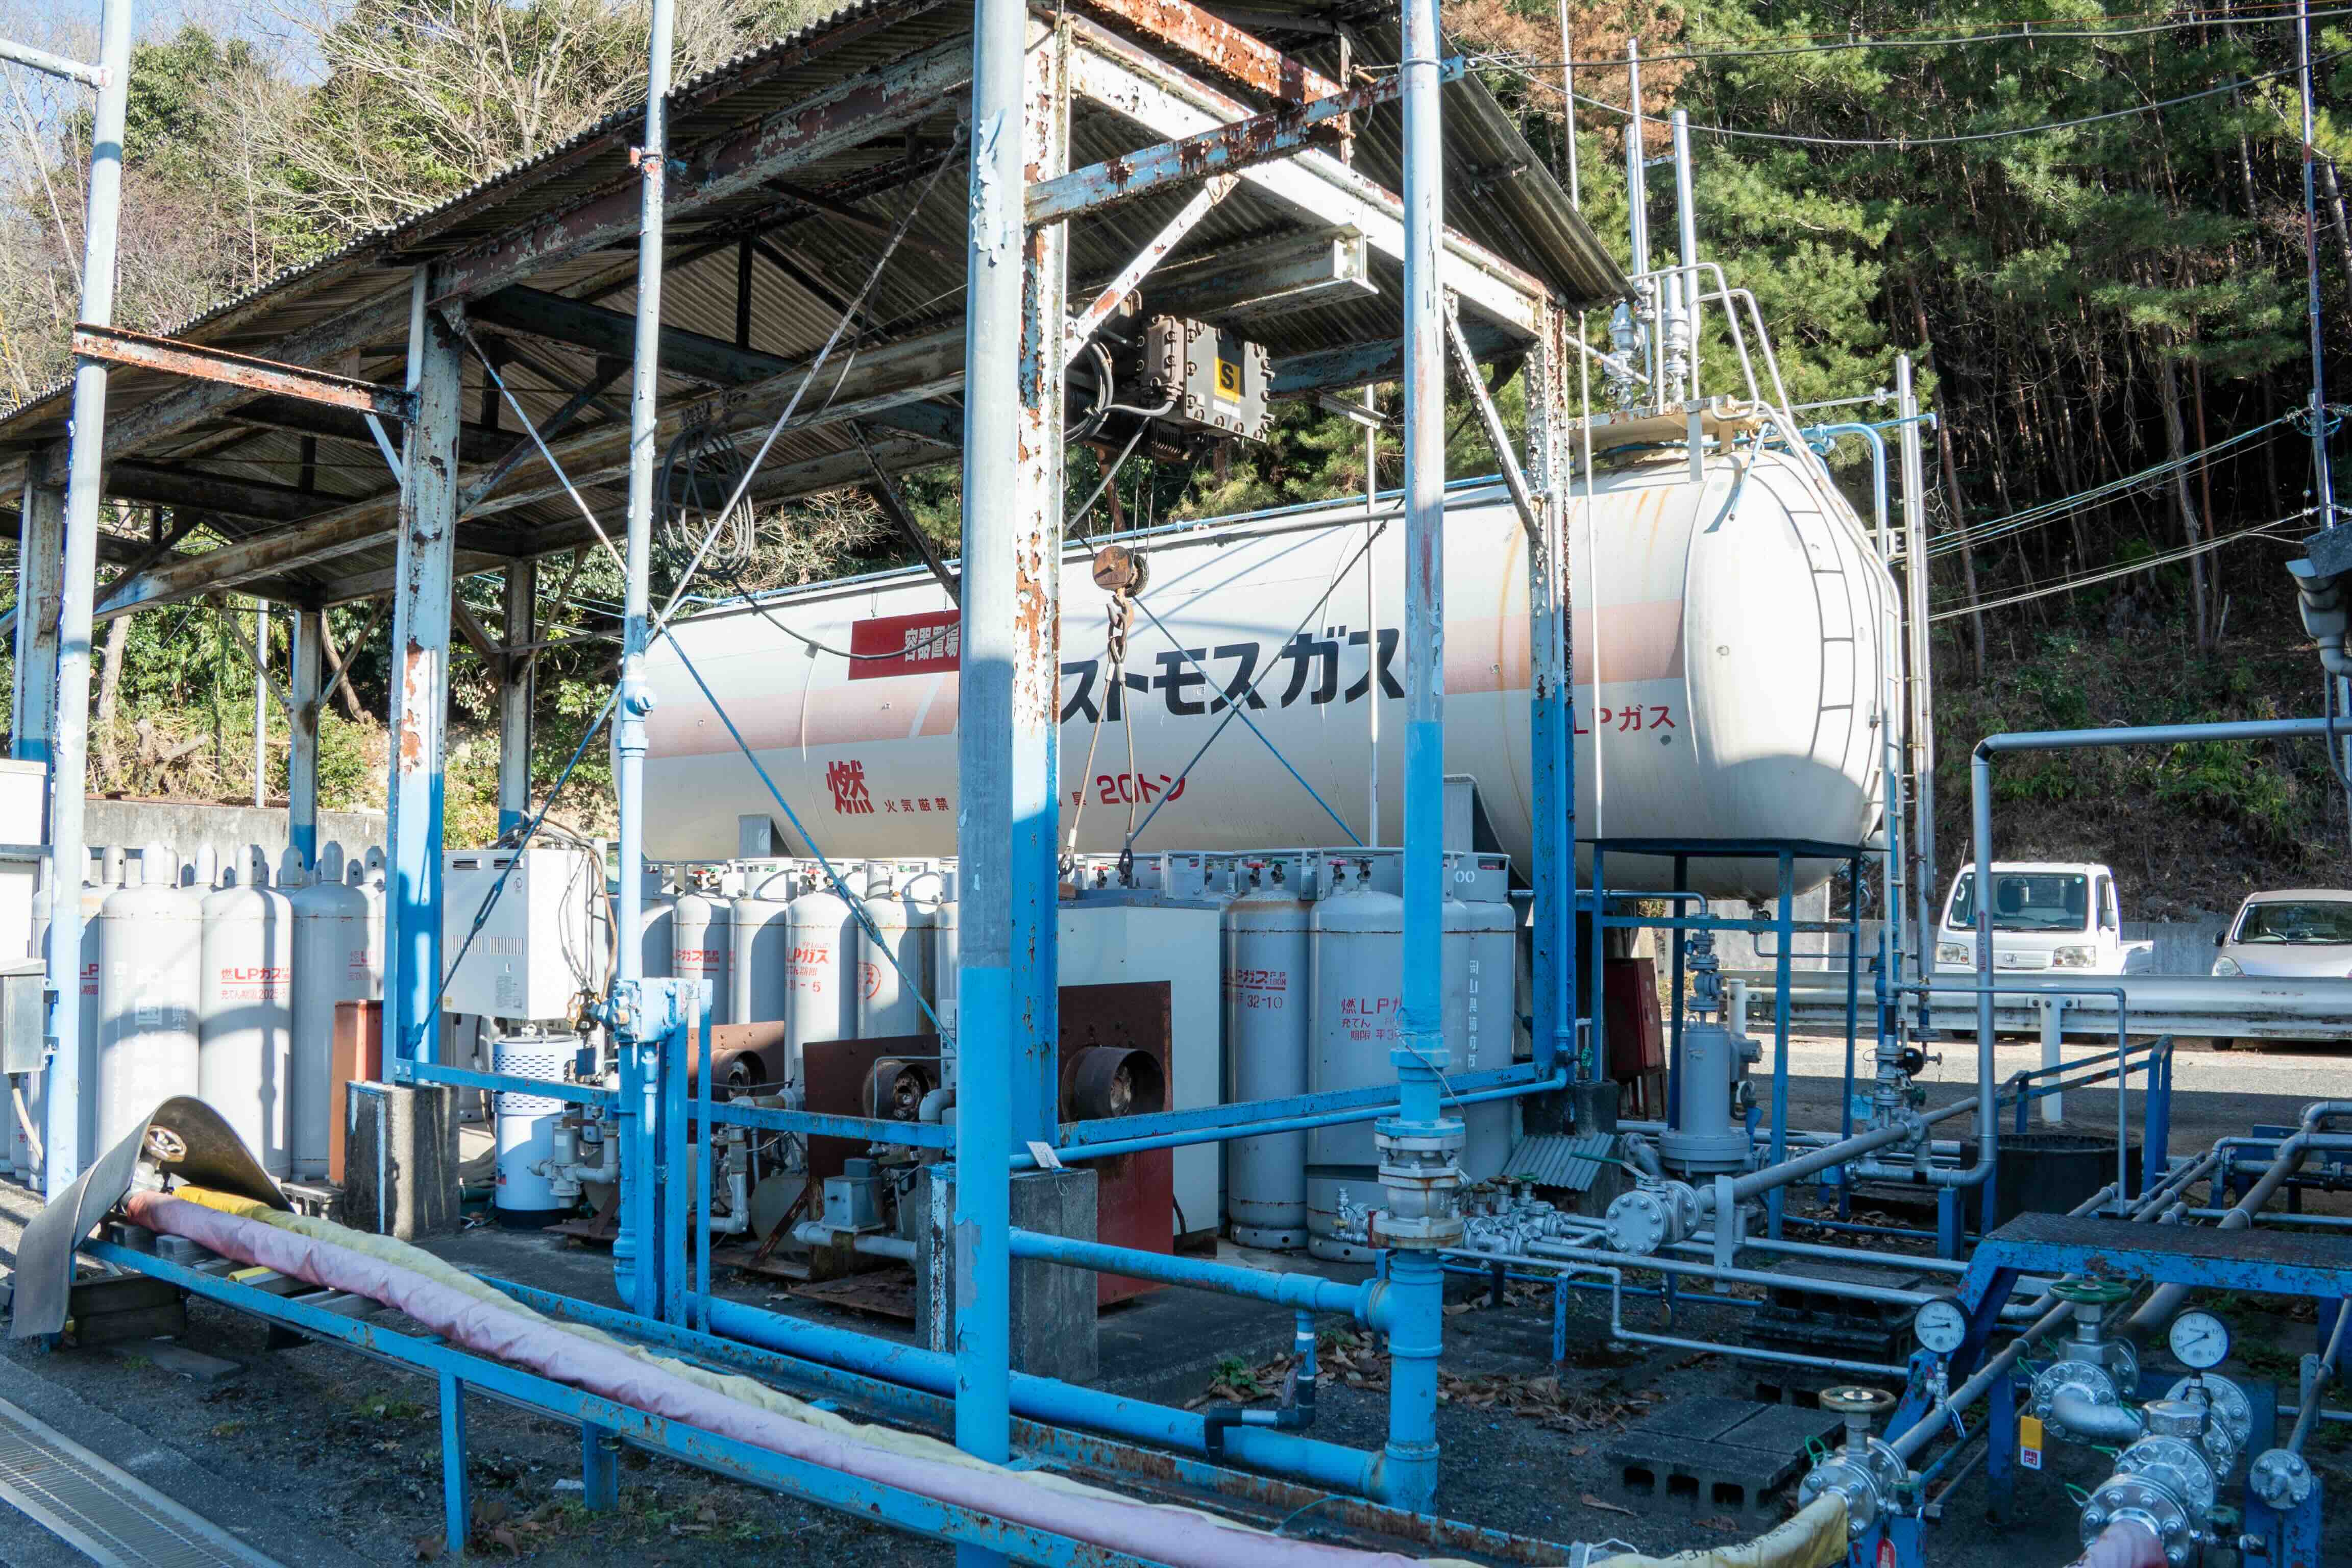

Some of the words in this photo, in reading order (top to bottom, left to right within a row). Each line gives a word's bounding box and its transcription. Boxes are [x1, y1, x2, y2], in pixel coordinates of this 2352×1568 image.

[1220, 363, 1234, 389] S
[904, 624, 960, 662] 容器置場
[1060, 625, 1405, 725] ストモスガス
[825, 760, 874, 815] 燃
[885, 797, 949, 813] 火気厳禁
[1096, 773, 1186, 805] 20トン
